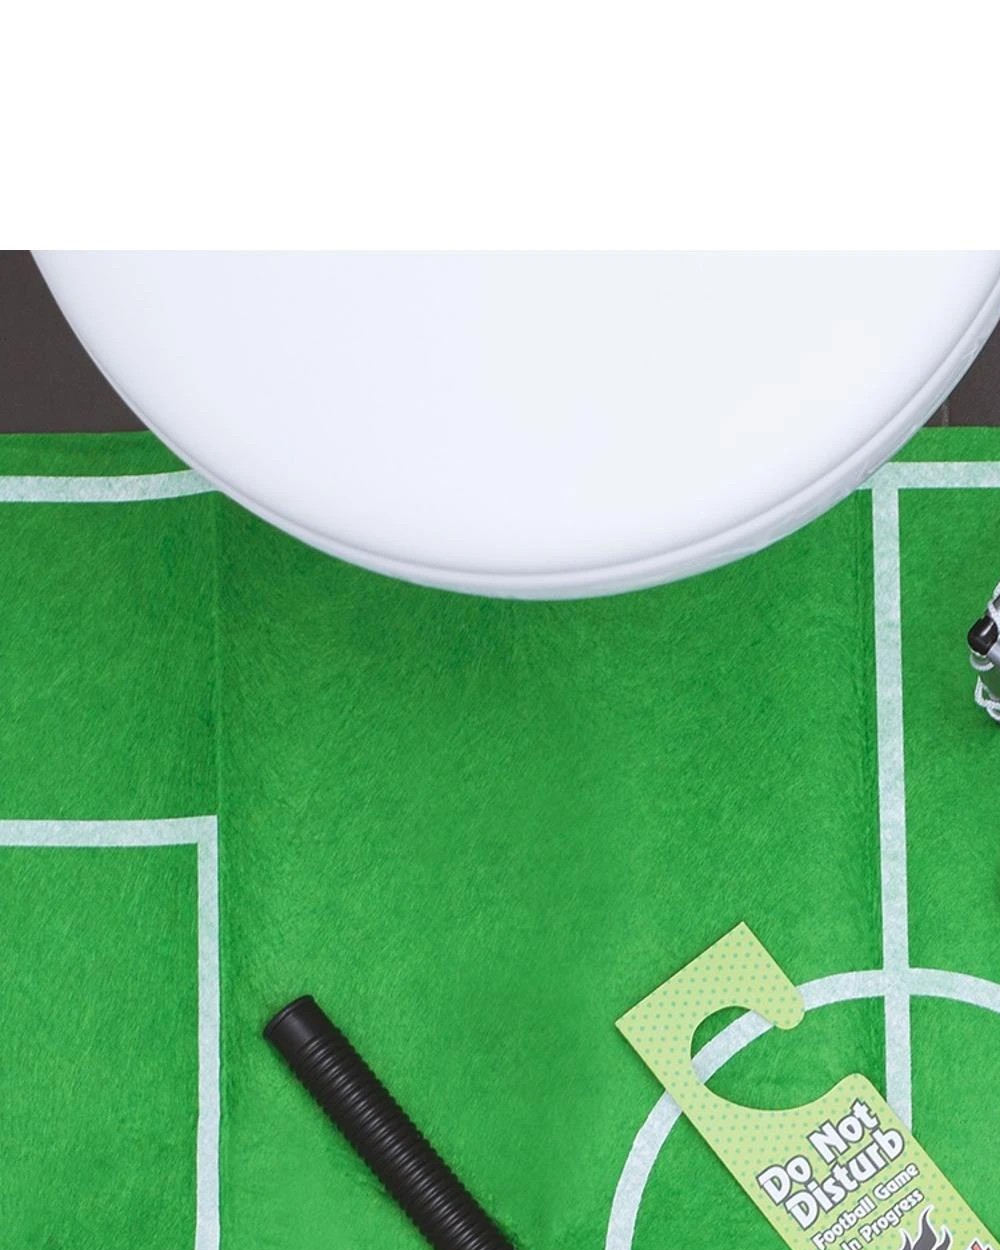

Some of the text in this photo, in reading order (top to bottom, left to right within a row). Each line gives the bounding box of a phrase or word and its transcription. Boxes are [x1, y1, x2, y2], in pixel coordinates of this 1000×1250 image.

[757, 1099, 880, 1205] Do Not
[783, 1128, 905, 1230] Disturb
[874, 1163, 919, 1201] Game
[860, 1189, 924, 1244] Progress
